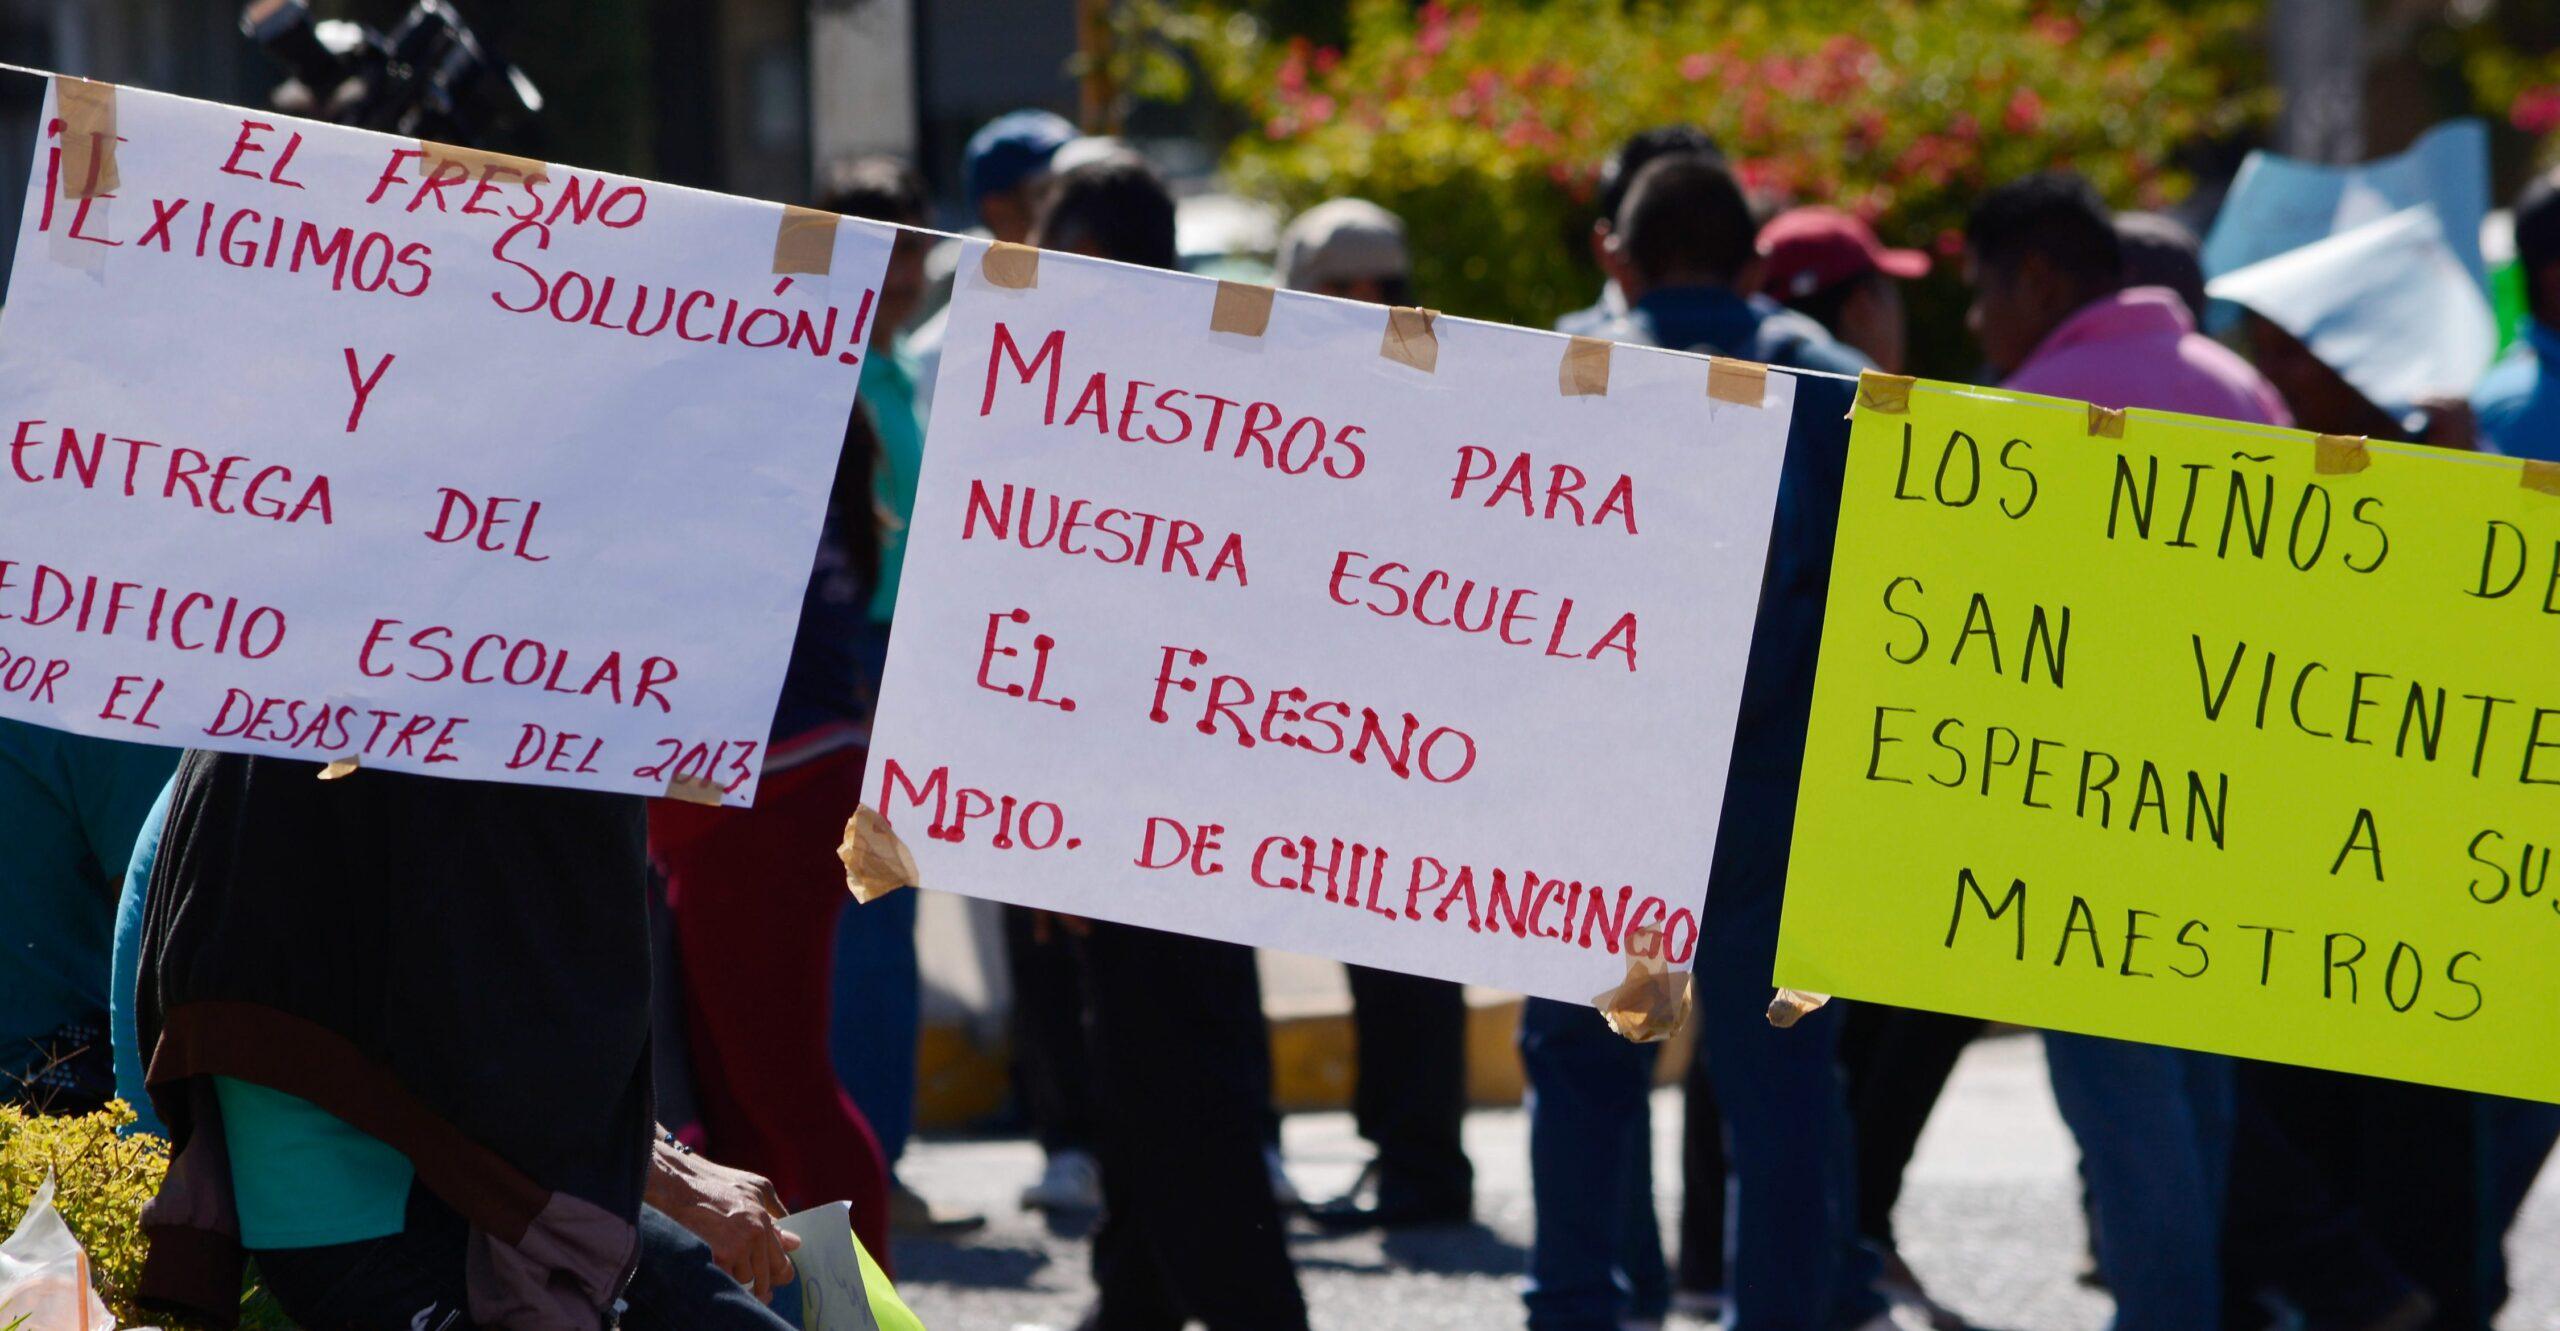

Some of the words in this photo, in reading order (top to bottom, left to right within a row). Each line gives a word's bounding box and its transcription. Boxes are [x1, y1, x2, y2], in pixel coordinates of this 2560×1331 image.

[221, 121, 302, 187] EL
[367, 149, 646, 230] FRESNO
[345, 348, 394, 432] Y
[981, 323, 1365, 478] MAESTROS
[1452, 446, 1637, 535] PARA
[12, 420, 331, 524] ENTREGA
[425, 487, 549, 562] DEL
[1895, 423, 2037, 519] LOS
[2107, 449, 2388, 573] NIÑOS
[0, 561, 285, 662] EDIFICIO
[360, 620, 677, 714] ESCOLAR
[963, 480, 1247, 586] NUESTRA
[1330, 552, 1636, 672] ESCUELA
[100, 676, 163, 726] EL
[203, 687, 468, 763] DESASTRE
[506, 724, 604, 773] DEL
[977, 608, 1076, 711] EL
[1150, 646, 1475, 783] FRESNO
[1884, 577, 2070, 688] SAN
[2190, 635, 2560, 787] VICENTE
[878, 758, 1082, 850] MPIO.
[1135, 817, 1224, 876] DE
[1251, 836, 1698, 964] CHILPANCINGO
[1867, 704, 2227, 850] ESPERAN
[2331, 809, 2384, 881] A
[2469, 830, 2560, 913] SU
[1942, 865, 2486, 1023] MAESTROS
